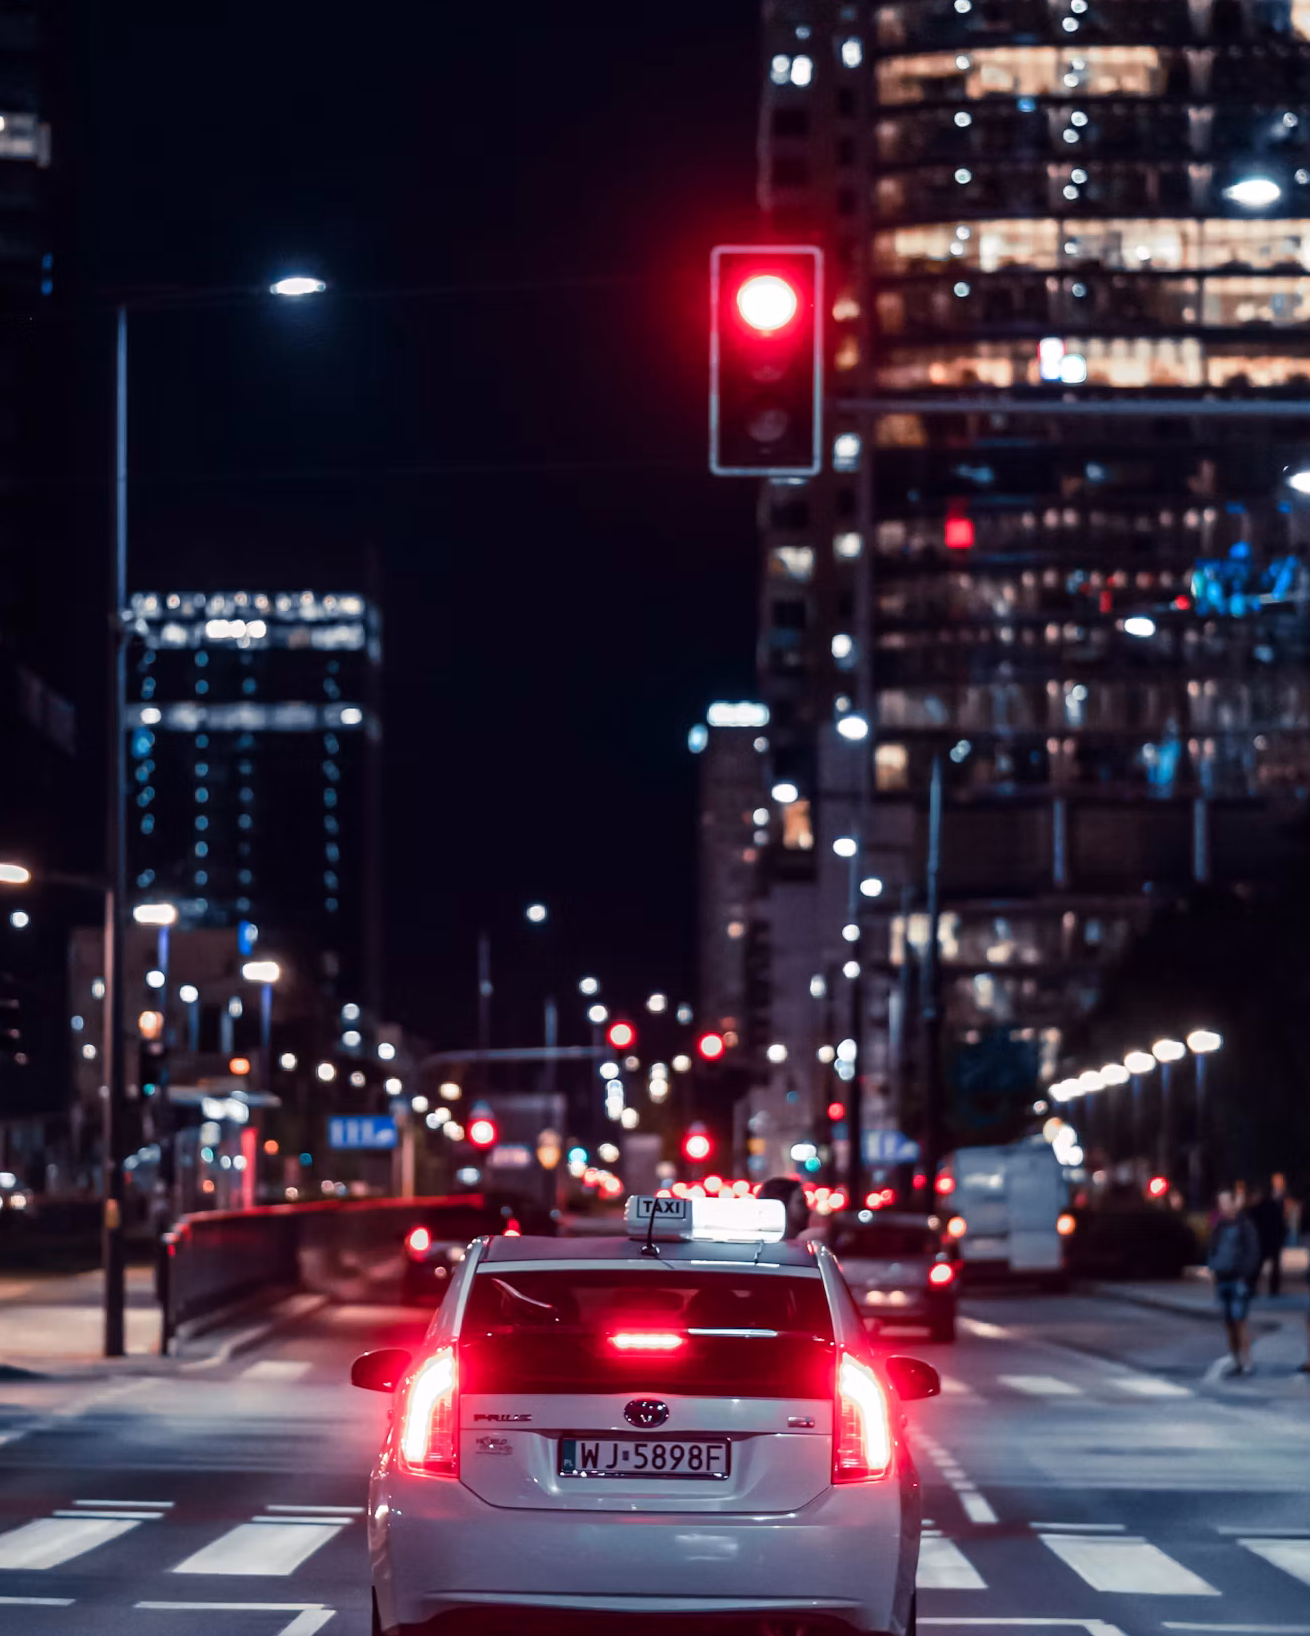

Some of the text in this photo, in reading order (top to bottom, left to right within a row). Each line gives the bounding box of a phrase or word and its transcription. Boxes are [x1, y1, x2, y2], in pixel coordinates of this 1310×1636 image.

[643, 1200, 680, 1213] TAXI
[581, 1442, 723, 1471] WJ 5898F
